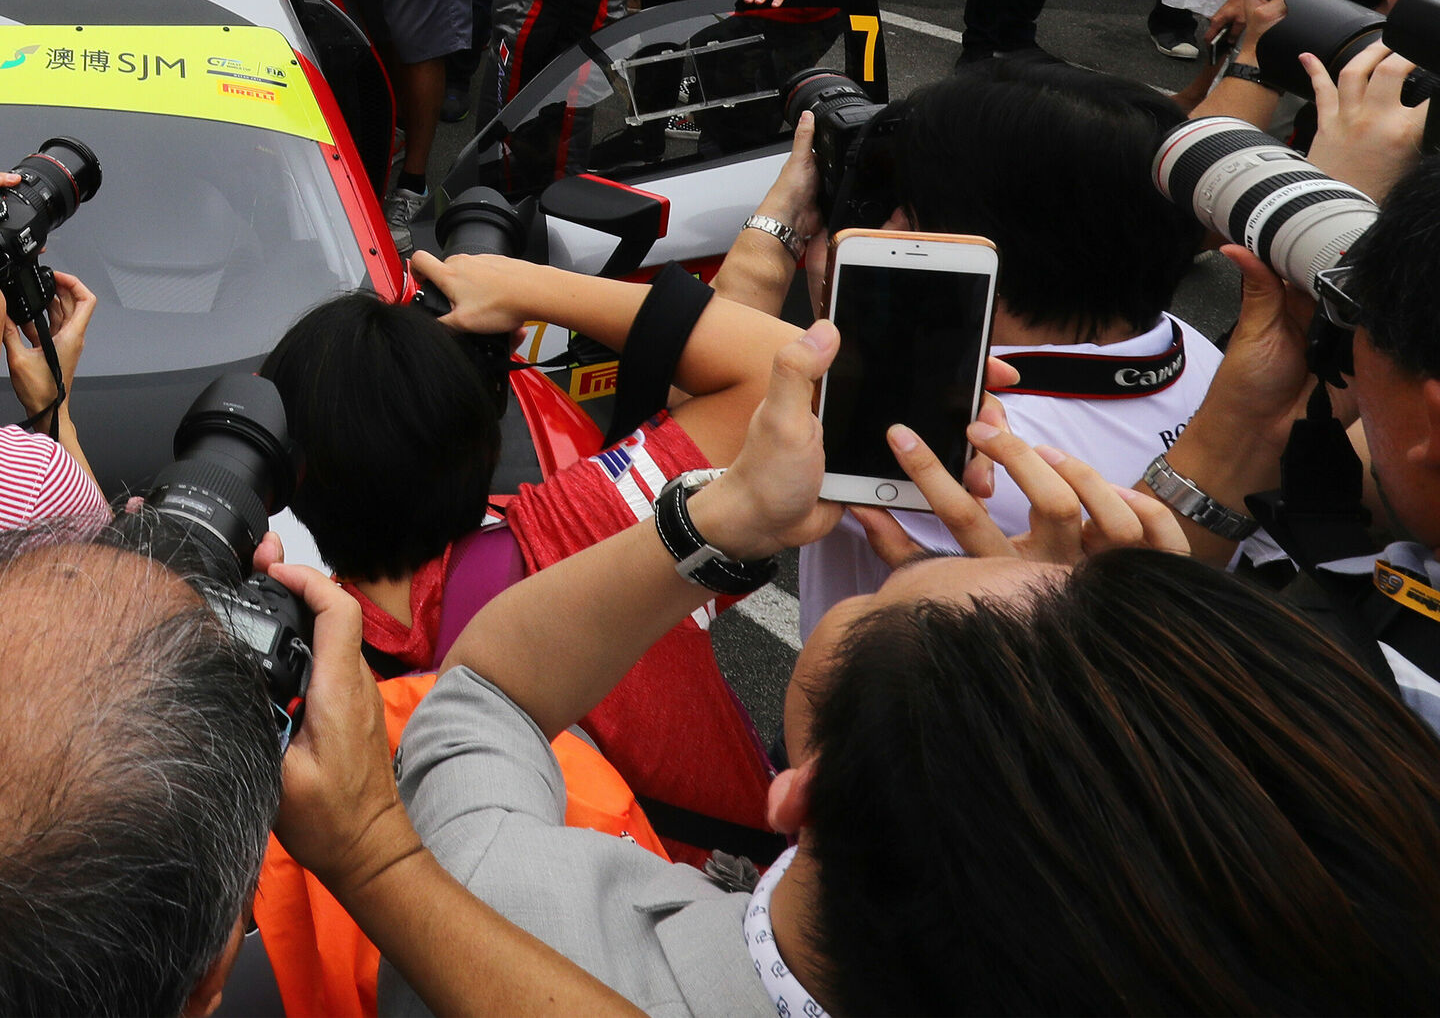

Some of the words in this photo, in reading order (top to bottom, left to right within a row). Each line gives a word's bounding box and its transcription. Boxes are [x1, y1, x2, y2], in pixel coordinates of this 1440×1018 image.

[45, 47, 111, 73] 澳博
[117, 52, 187, 81] SJM
[849, 15, 879, 82] 7
[266, 66, 285, 78] FIA
[222, 83, 275, 101] PIRELLI
[1114, 354, 1183, 387] Canon
